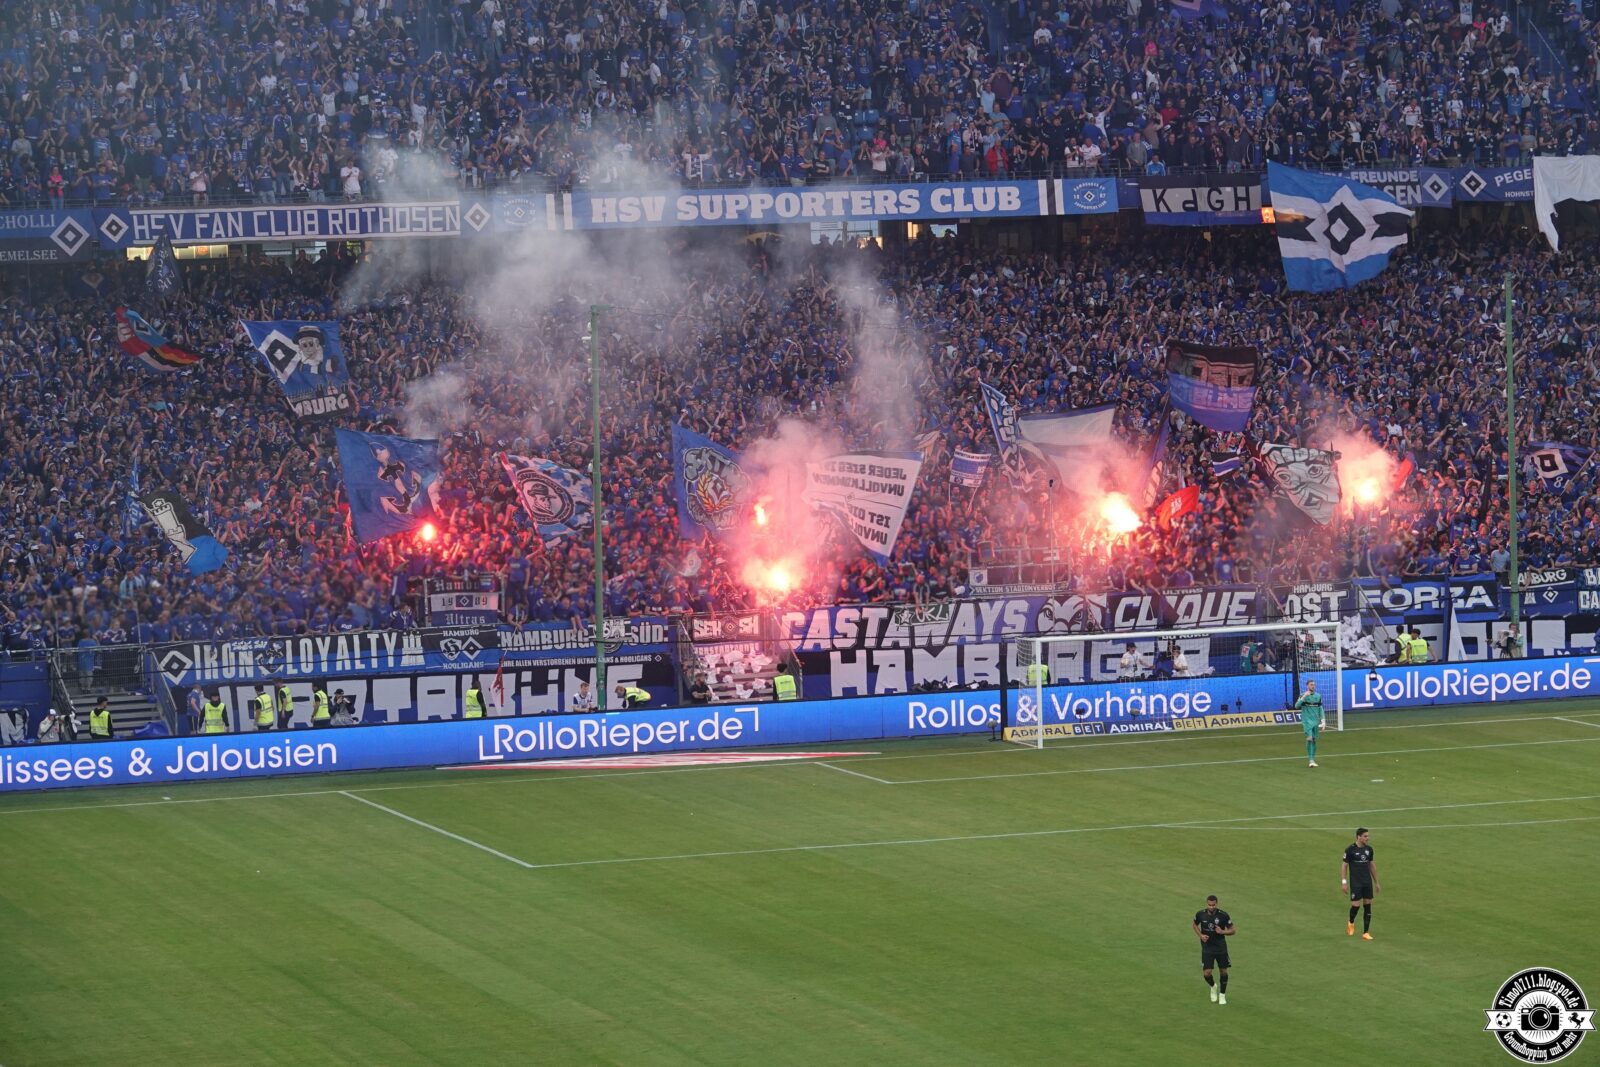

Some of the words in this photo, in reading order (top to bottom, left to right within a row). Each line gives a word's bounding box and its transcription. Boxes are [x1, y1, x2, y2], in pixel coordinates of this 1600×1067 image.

[1494, 168, 1534, 187] PEGE
[1383, 184, 1423, 206] SEN
[1504, 190, 1534, 198] HOHNST
[590, 196, 666, 224] HSV
[676, 188, 922, 222] SUPPORTERS
[930, 185, 1021, 214] CLUB
[133, 210, 184, 240] HSV
[195, 211, 244, 239] FAN
[254, 209, 319, 237] CLUB
[328, 204, 462, 234] ROTHOSEN
[434, 579, 480, 592] Hambu
[1509, 568, 1567, 585] ABURG
[1162, 587, 1204, 595] ULTRAS
[1293, 583, 1333, 593] HAMBURG
[1285, 590, 1347, 623] OST
[442, 628, 480, 637] HAMBURG
[630, 622, 664, 646] SÜD
[779, 599, 1030, 650] CASTAWAYS
[193, 641, 255, 680] IRON
[285, 631, 397, 675] LOYALTY
[442, 661, 484, 670] HOOLIGANS
[1365, 662, 1592, 702] RolloRieper.de
[908, 700, 1001, 729] Rollos
[1016, 695, 1038, 723] &
[1050, 688, 1212, 720] Vorhänge
[1073, 724, 1102, 734] BET
[1110, 721, 1173, 734] ADMIRAL
[1175, 719, 1204, 729] BET
[1210, 714, 1273, 728] ADMIRAL
[493, 715, 744, 754] RolloRieper.de
[127, 748, 153, 777] &
[166, 739, 338, 775] Jalousien
